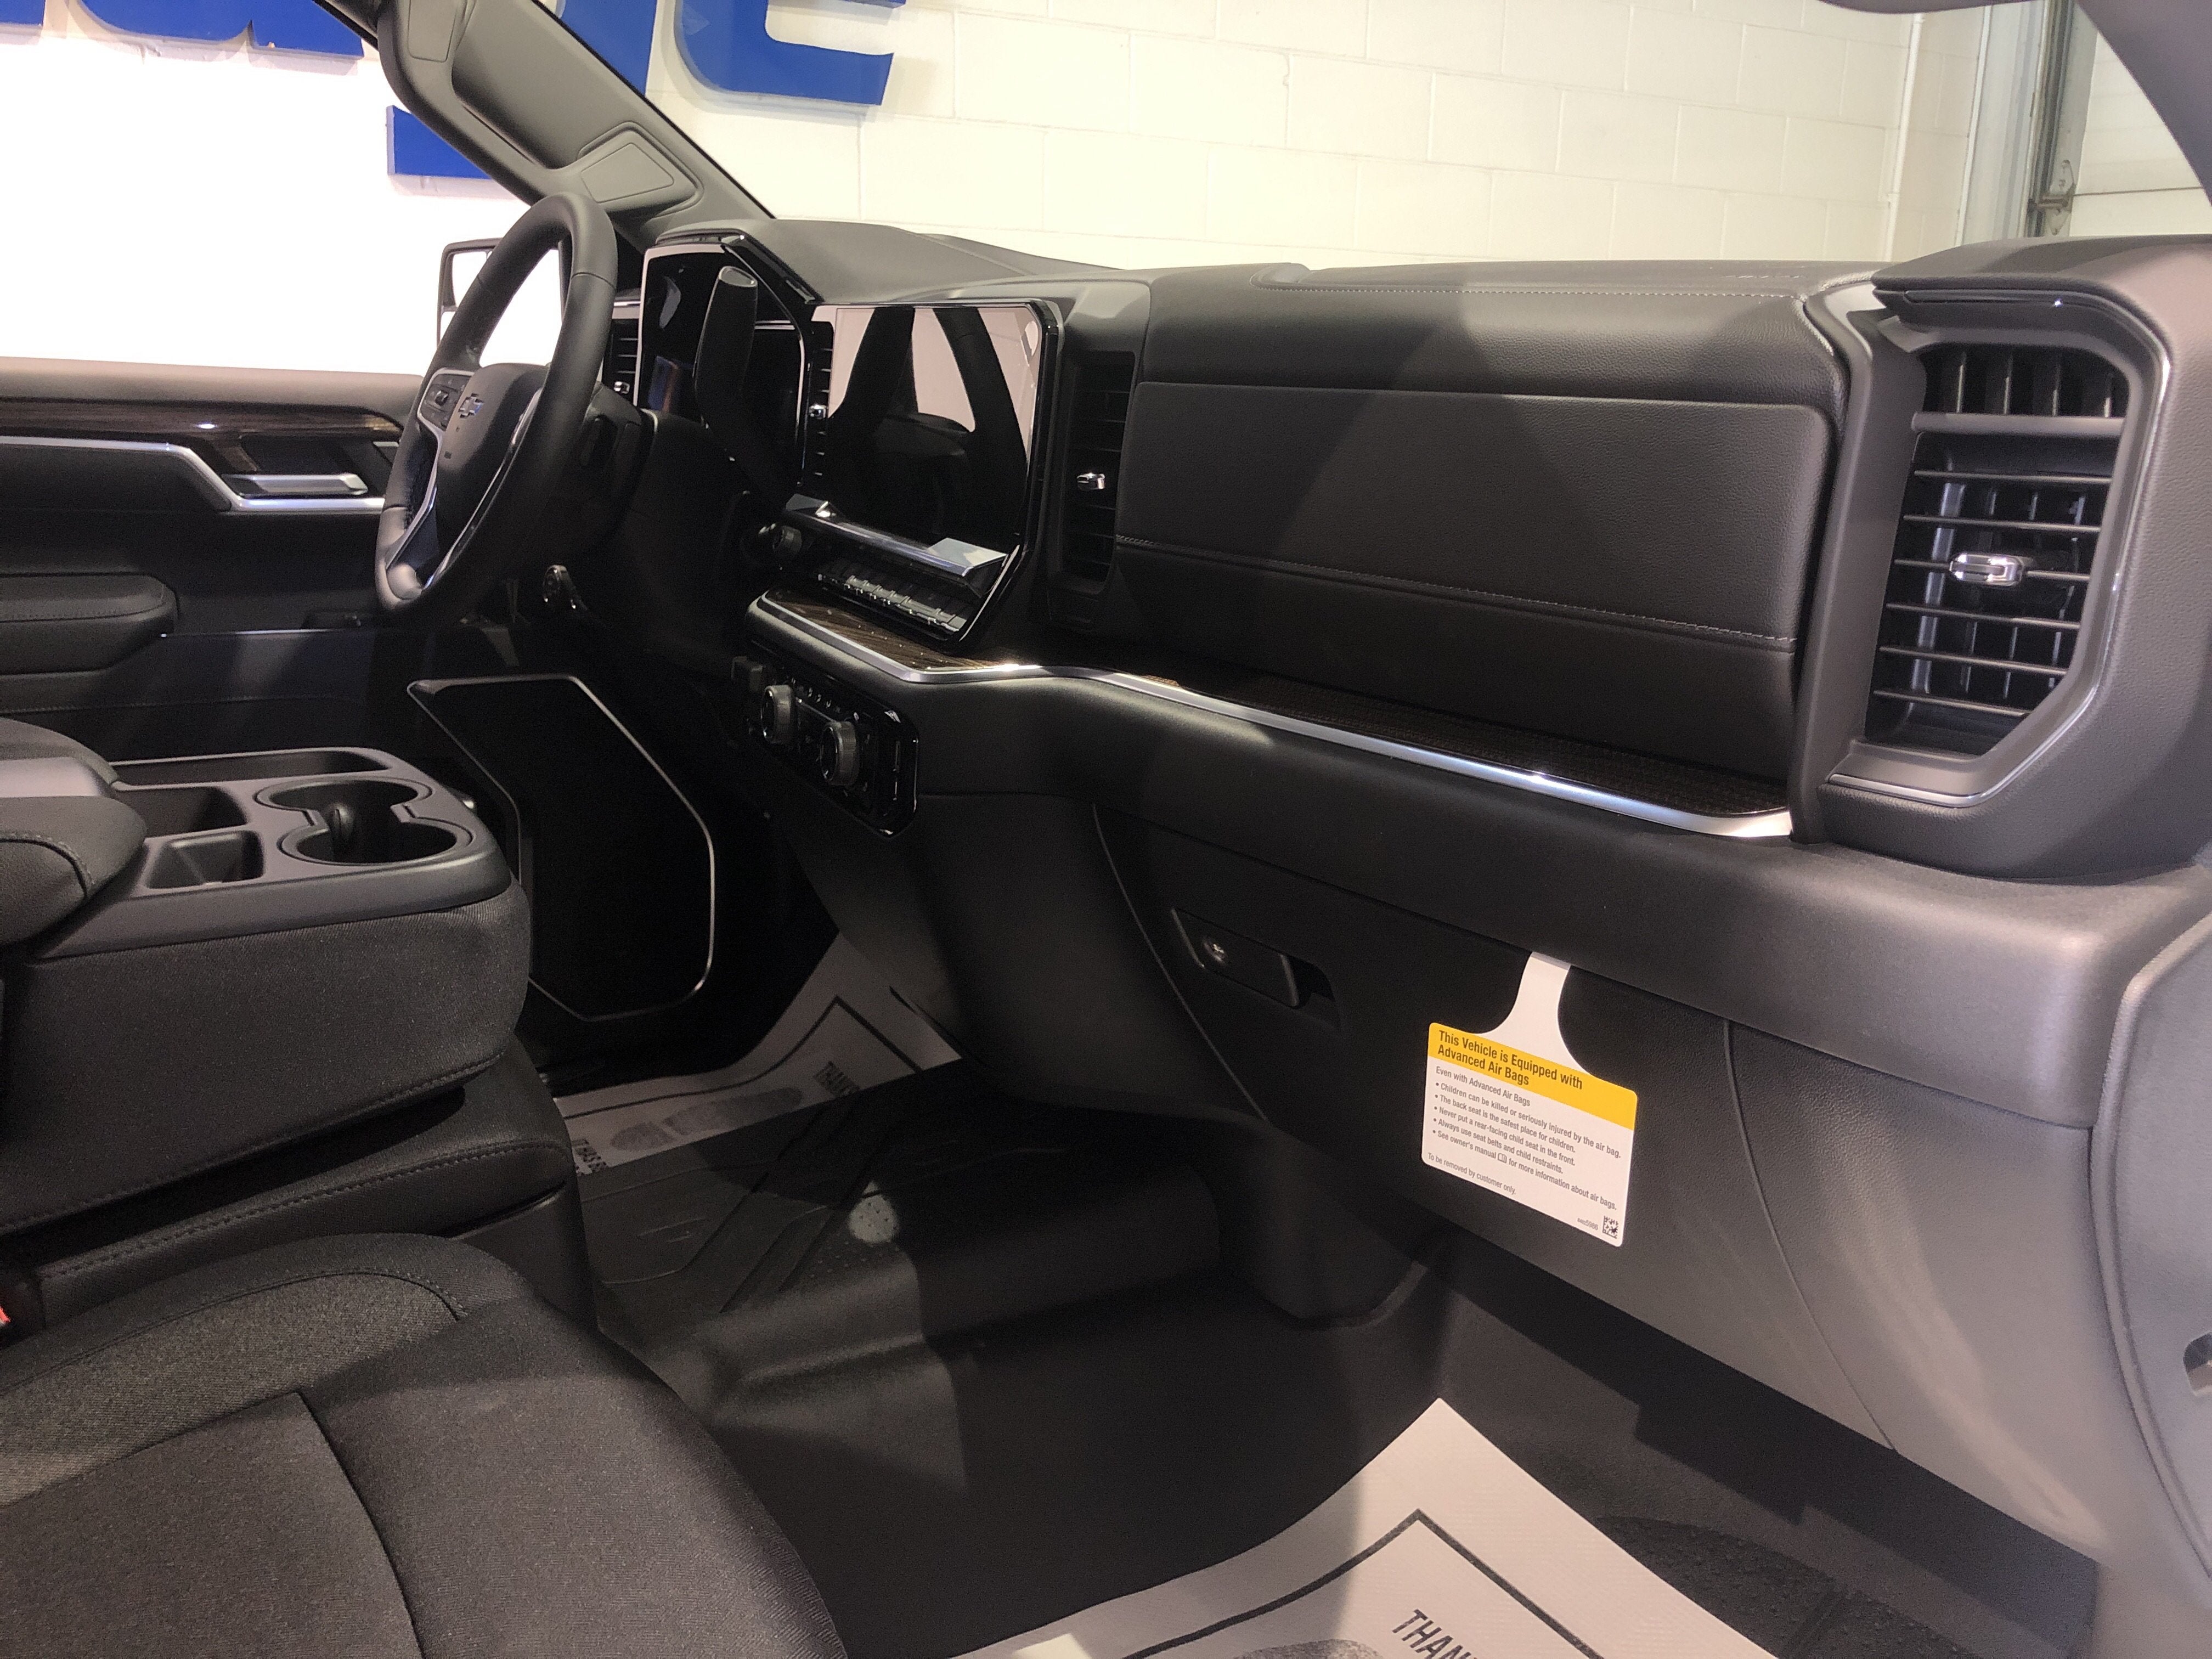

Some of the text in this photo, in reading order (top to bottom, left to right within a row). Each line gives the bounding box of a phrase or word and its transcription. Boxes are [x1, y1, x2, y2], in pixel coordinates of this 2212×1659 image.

[1436, 1065, 1531, 1107] Even with Advanced Air Bags
[1437, 1044, 1530, 1086] Advanced Air Bags
[1438, 1029, 1583, 1090] This Vehicle is Equipped with
[1438, 1118, 1564, 1174] Always use seat belts and child restraints.
[1439, 1106, 1457, 1119] Never
[1458, 1114, 1468, 1124] put
[1474, 1120, 1508, 1140] rear-facing
[1509, 1134, 1524, 1145] child
[1525, 1140, 1539, 1151] seat
[1539, 1146, 1546, 1154] in
[1547, 1148, 1558, 1159] the
[1559, 1153, 1576, 1166] front.
[1440, 1094, 1576, 1153] The back seat is the safest place for children.
[1441, 1082, 1467, 1098] Children
[1468, 1093, 1480, 1103] can
[1481, 1097, 1489, 1107] be
[1491, 1101, 1509, 1114] killed
[1518, 1112, 1548, 1130] seriously
[1549, 1123, 1572, 1138] injured
[1573, 1132, 1582, 1143] by
[1583, 1136, 1594, 1147] the
[1595, 1143, 1605, 1152] air
[1606, 1146, 1621, 1159] bag.
[1427, 1152, 1516, 1195] To be removed by customer only.
[1437, 1130, 1617, 1211] See owner's manual for more information about air bags.
[1392, 1609, 1477, 1659] THAN
